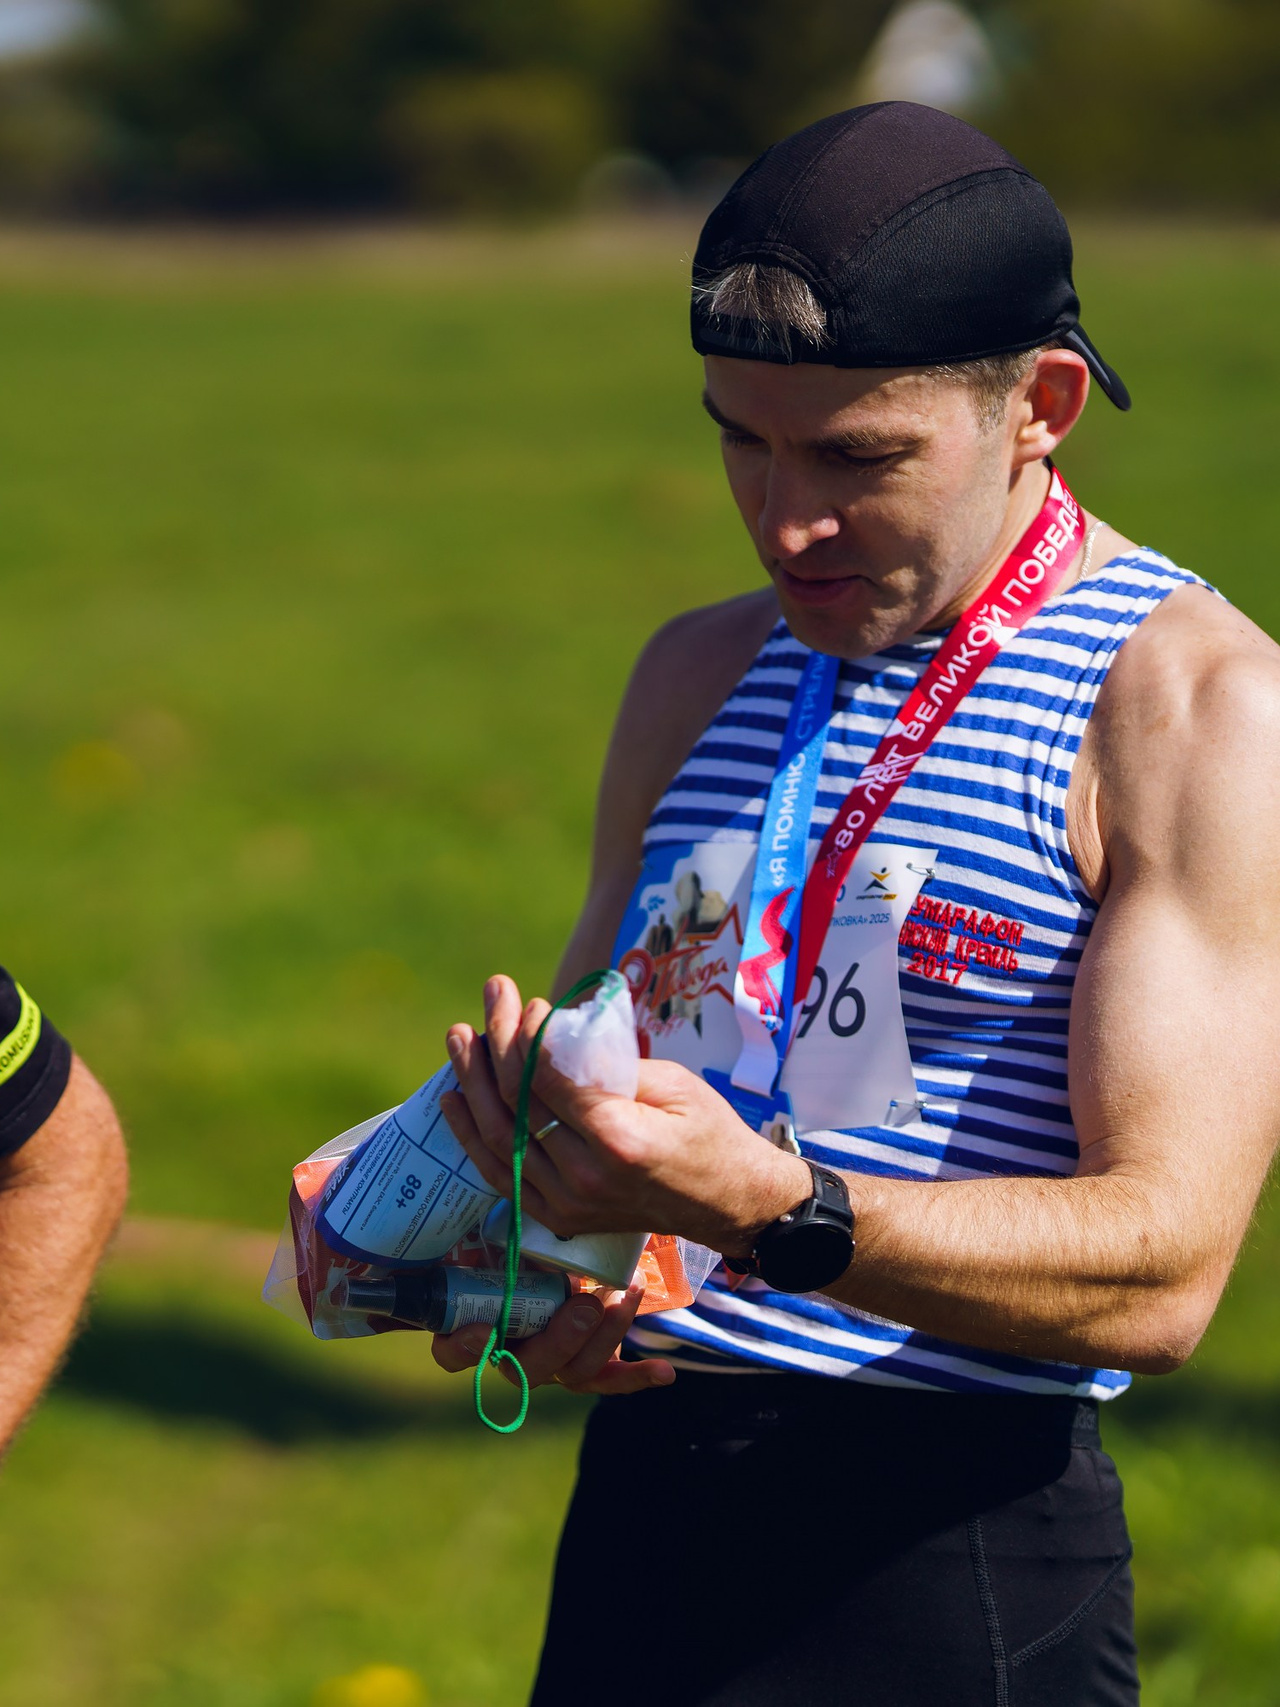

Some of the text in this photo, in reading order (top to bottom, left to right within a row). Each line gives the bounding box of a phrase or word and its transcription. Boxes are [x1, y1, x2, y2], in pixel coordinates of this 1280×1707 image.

[834, 810, 866, 850] 80
[864, 743, 906, 805] ЛЕТ
[902, 603, 1012, 742] ВЕЛИКОЙ
[869, 913, 891, 924] 2025
[910, 894, 1025, 946] УМАРАФОН
[907, 952, 969, 985] 2017
[341, 1177, 365, 1215] КОНТРАКТЫ
[391, 1172, 424, 1212] 89+
[422, 1169, 446, 1204] ПОСТАВКИ
